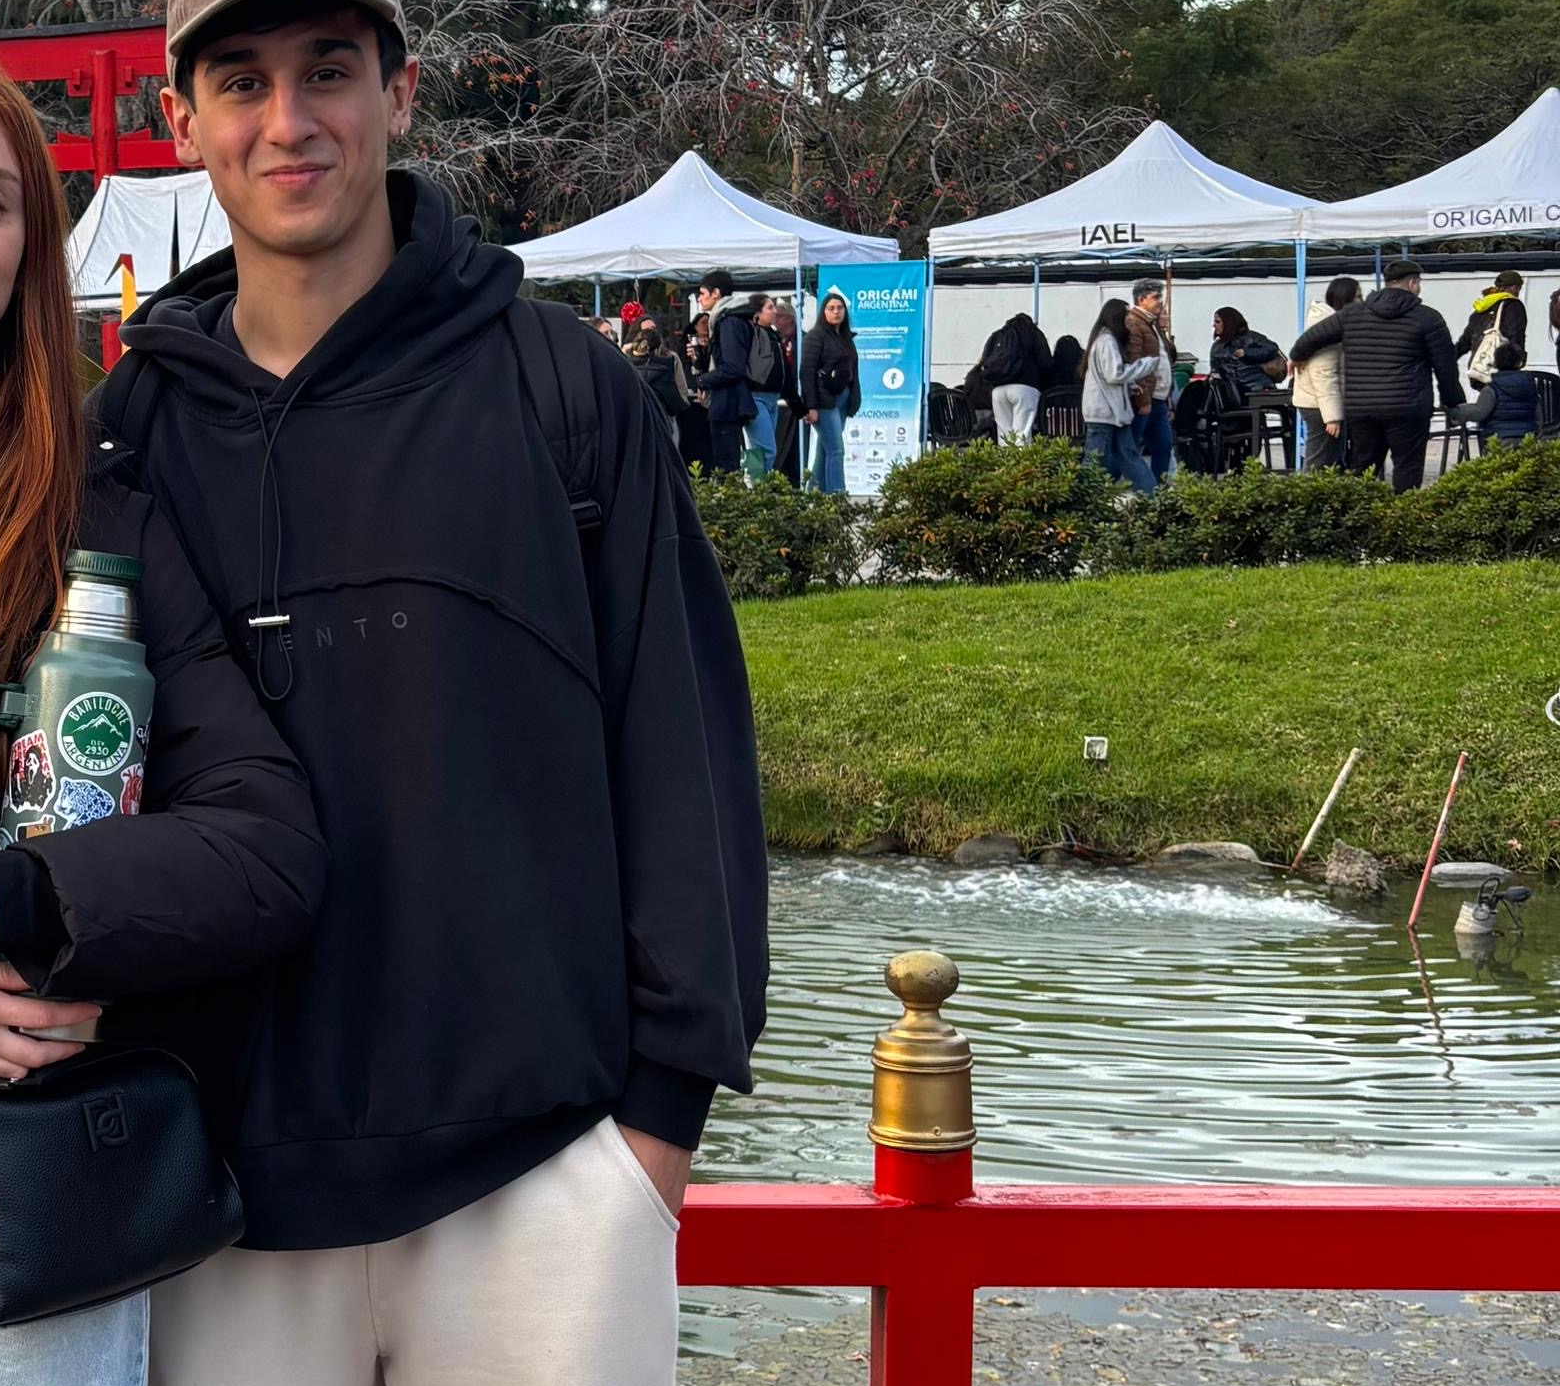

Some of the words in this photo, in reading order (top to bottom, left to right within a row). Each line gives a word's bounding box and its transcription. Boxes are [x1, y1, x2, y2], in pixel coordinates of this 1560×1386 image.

[1433, 206, 1533, 229] ORIGAMI
[1081, 223, 1144, 245] IAEL
[856, 288, 918, 301] ORIGAMI
[857, 300, 909, 310] ARGENTINA
[858, 409, 900, 419] ACIONES
[68, 697, 130, 726] BARILOCHE
[63, 741, 128, 771] ARGENTINA
[84, 745, 109, 756] 2930
